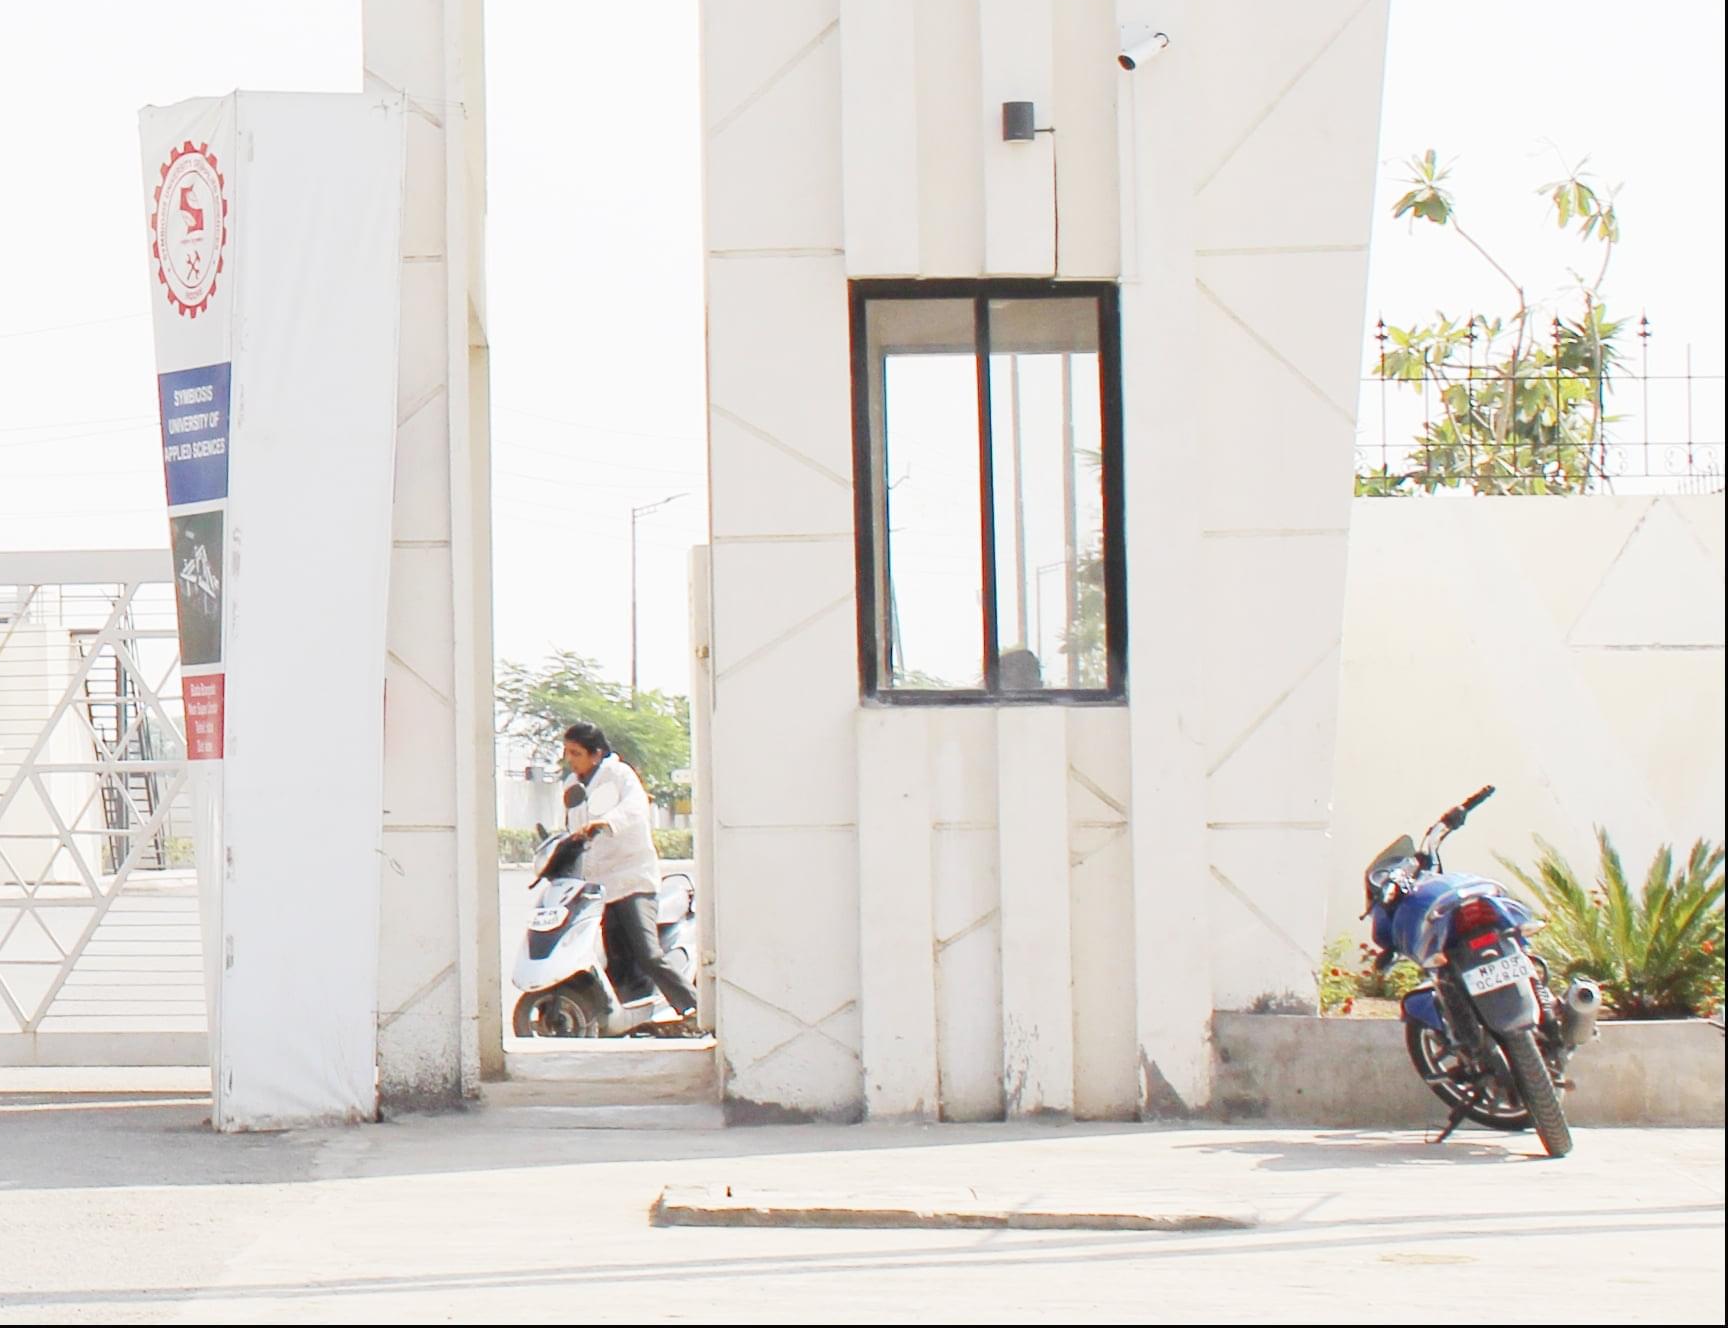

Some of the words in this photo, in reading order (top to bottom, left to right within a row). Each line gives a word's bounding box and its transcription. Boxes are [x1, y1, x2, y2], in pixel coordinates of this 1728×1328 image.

[174, 385, 213, 407] SYMBIOSIS
[168, 413, 208, 435] UNIVERSITY
[208, 411, 219, 428] OF
[164, 443, 192, 462] APPLIED
[192, 437, 225, 459] SCIENCES
